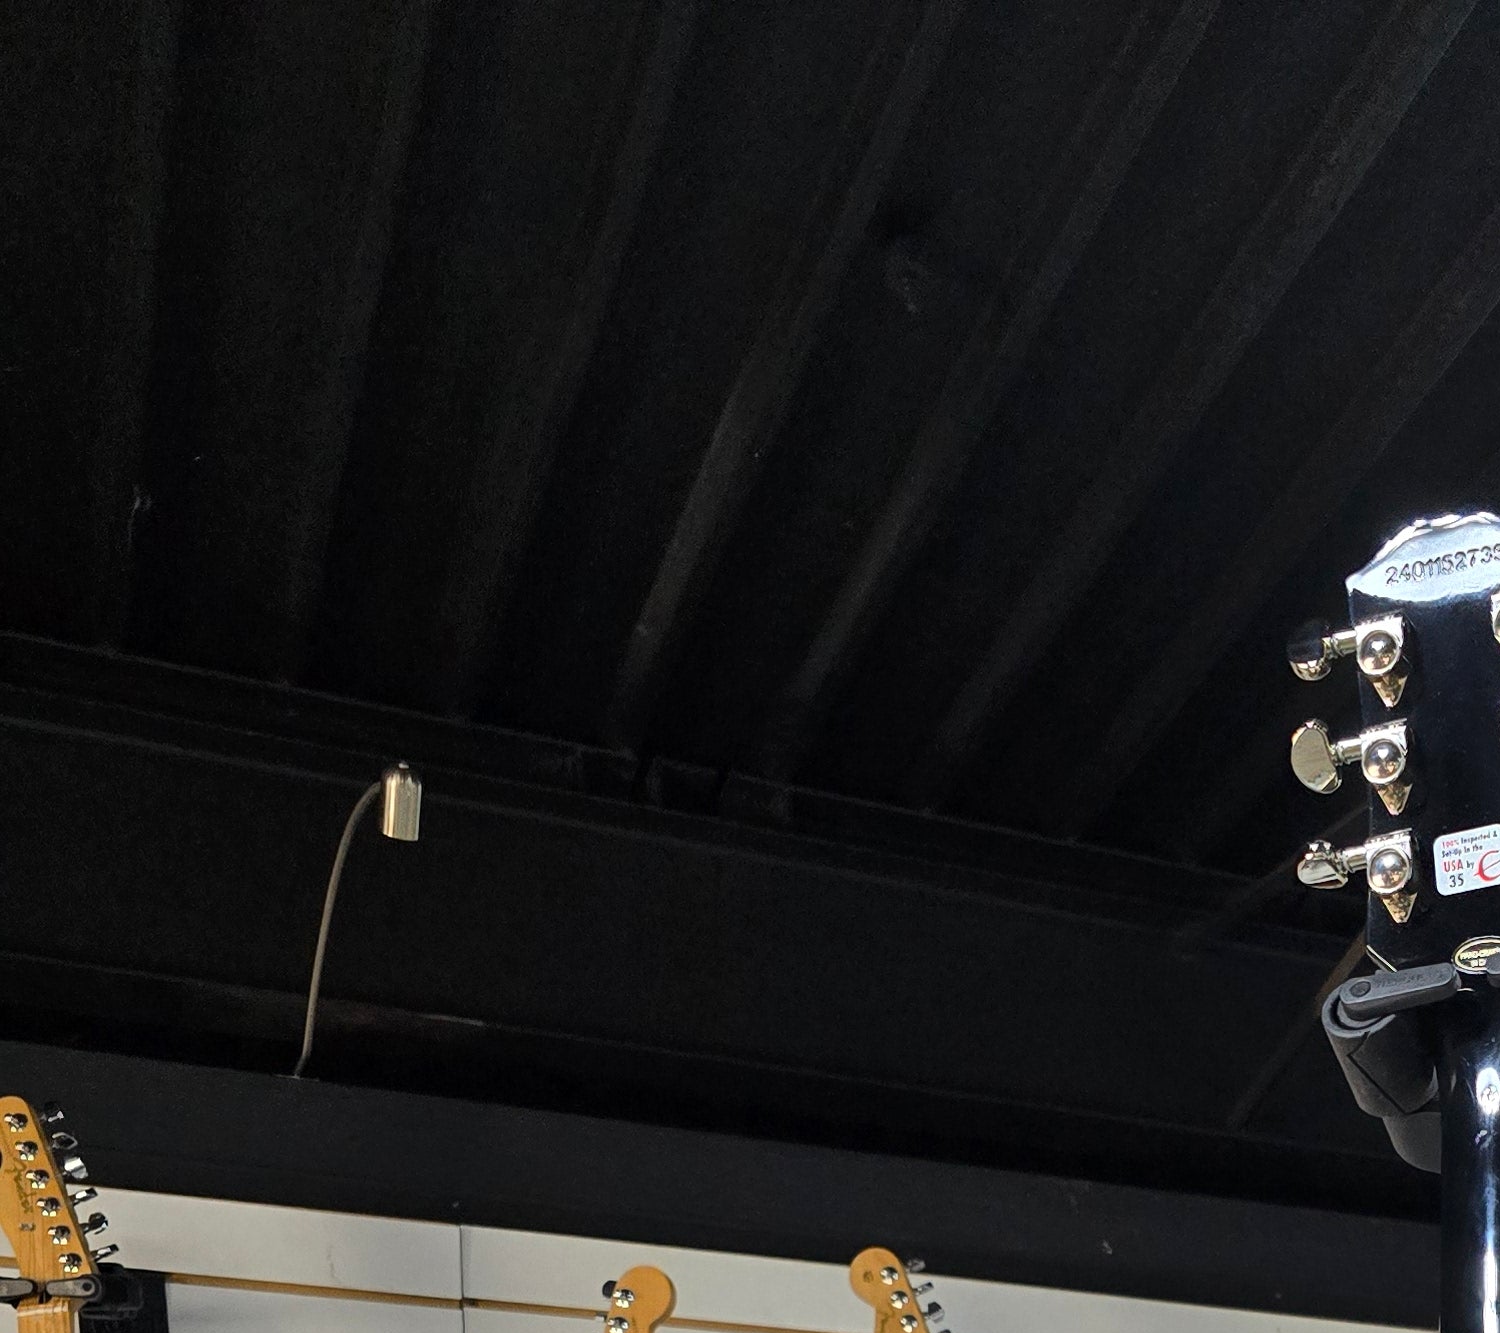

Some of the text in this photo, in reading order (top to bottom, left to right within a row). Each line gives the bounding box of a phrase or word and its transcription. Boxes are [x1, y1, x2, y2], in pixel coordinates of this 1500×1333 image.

[1443, 860, 1475, 873] USA by
[1449, 873, 1465, 888] 35
